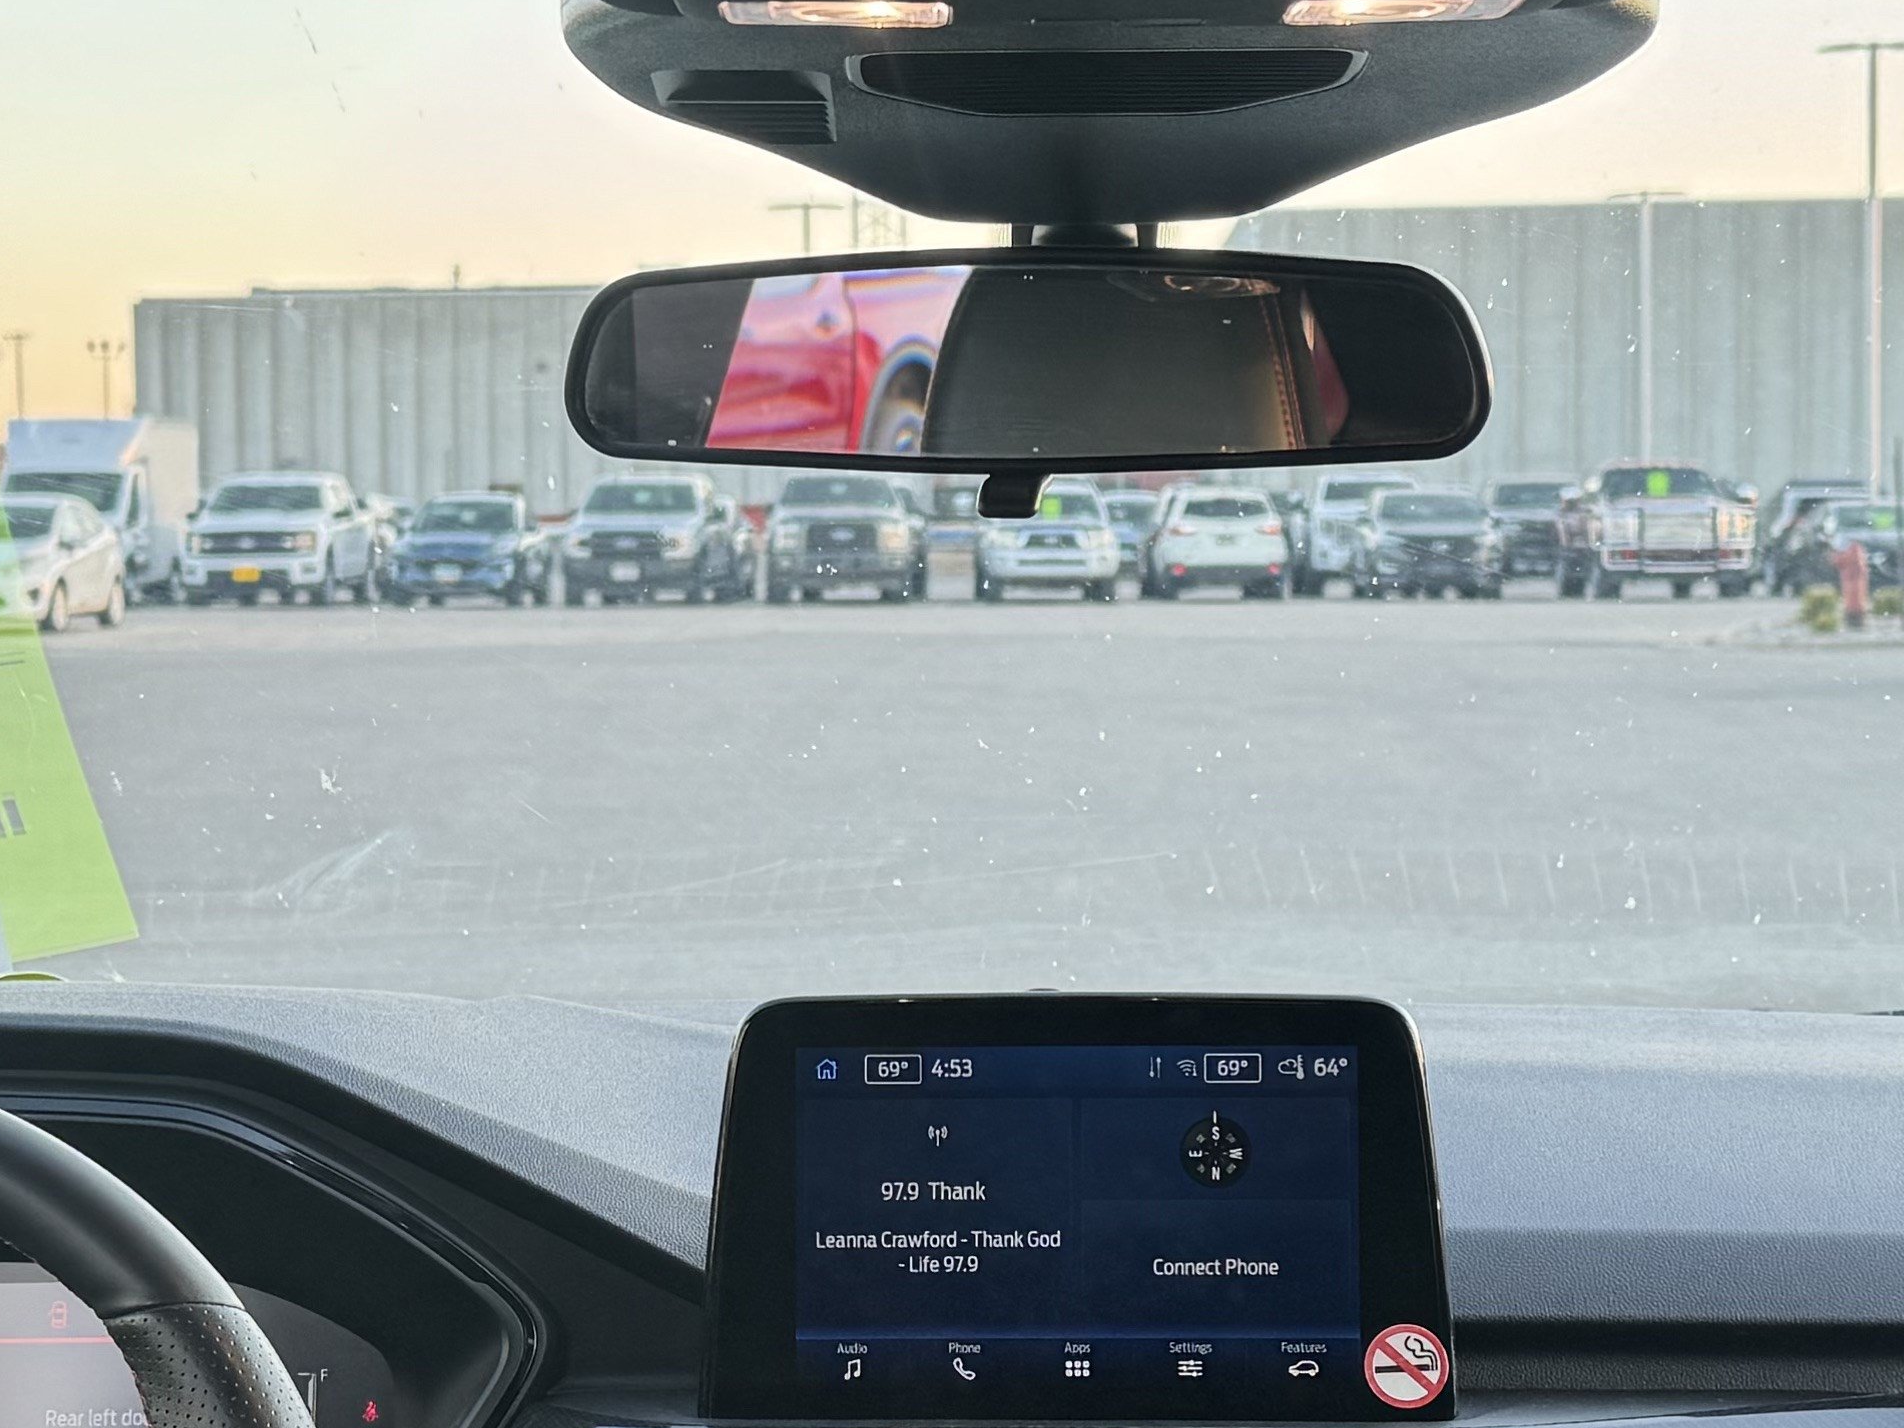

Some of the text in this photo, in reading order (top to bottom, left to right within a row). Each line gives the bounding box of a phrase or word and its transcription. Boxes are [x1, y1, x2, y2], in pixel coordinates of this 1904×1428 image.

[877, 1060, 909, 1079] 69°
[930, 1058, 973, 1079] 4:53
[1216, 1059, 1249, 1077] 69°
[1313, 1057, 1349, 1077] 64°
[1211, 1125, 1221, 1141] S
[1211, 1166, 1221, 1182] N
[880, 1180, 987, 1202] 97.9 Thank
[815, 1231, 878, 1250] Leanna
[880, 1230, 957, 1249] Crawford
[971, 1230, 1024, 1249] Thank
[1027, 1230, 1062, 1248] God
[908, 1255, 941, 1273] Life
[943, 1255, 980, 1273] 97.9
[1152, 1257, 1280, 1276] Connect Phone
[836, 1341, 868, 1355] Audio
[947, 1341, 981, 1355] Phone
[1063, 1342, 1092, 1357] Apps
[1168, 1341, 1213, 1357] Settings
[1280, 1341, 1328, 1356] Features
[319, 1367, 329, 1383] F
[44, 1408, 85, 1427] Rear
[88, 1408, 117, 1427] left
